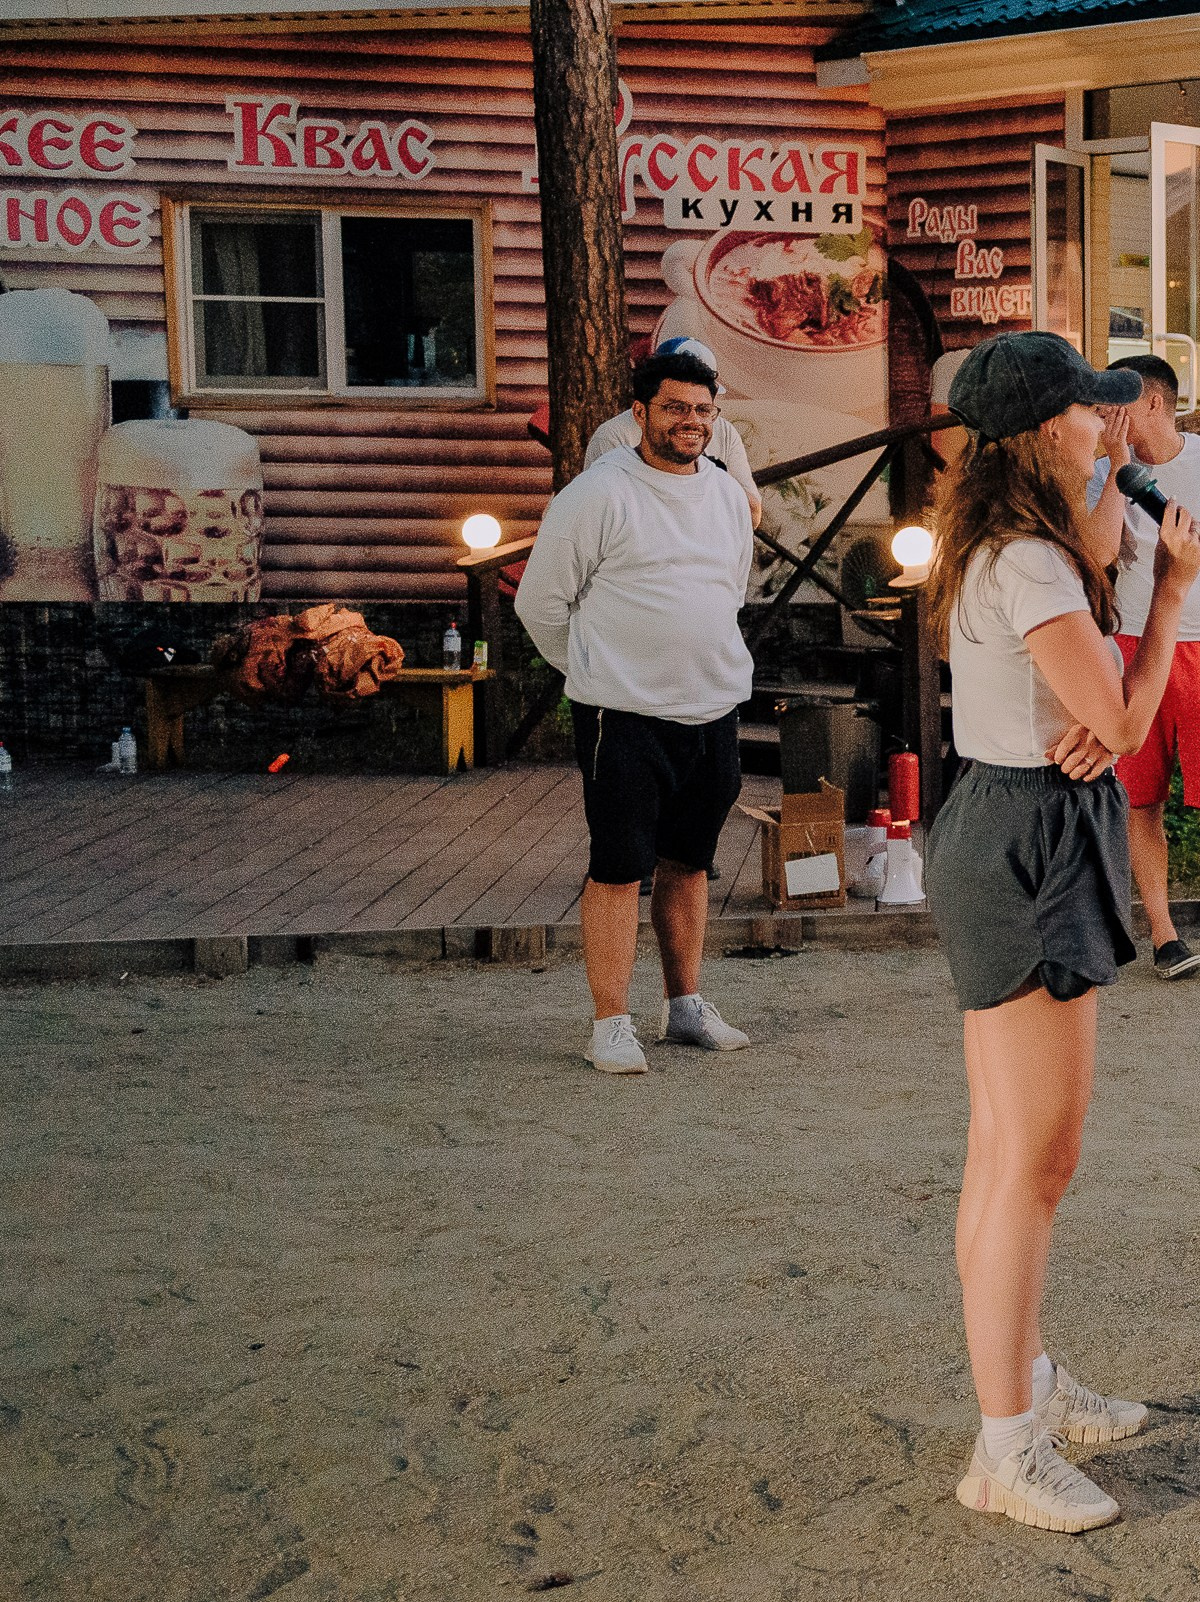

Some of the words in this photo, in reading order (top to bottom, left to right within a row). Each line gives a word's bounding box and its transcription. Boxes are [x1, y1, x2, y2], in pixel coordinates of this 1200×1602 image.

[232, 100, 431, 176] Квас
[680, 196, 855, 227] кухня
[908, 199, 977, 241] Рады
[956, 240, 1003, 278] Вас
[952, 286, 1032, 322] видет
